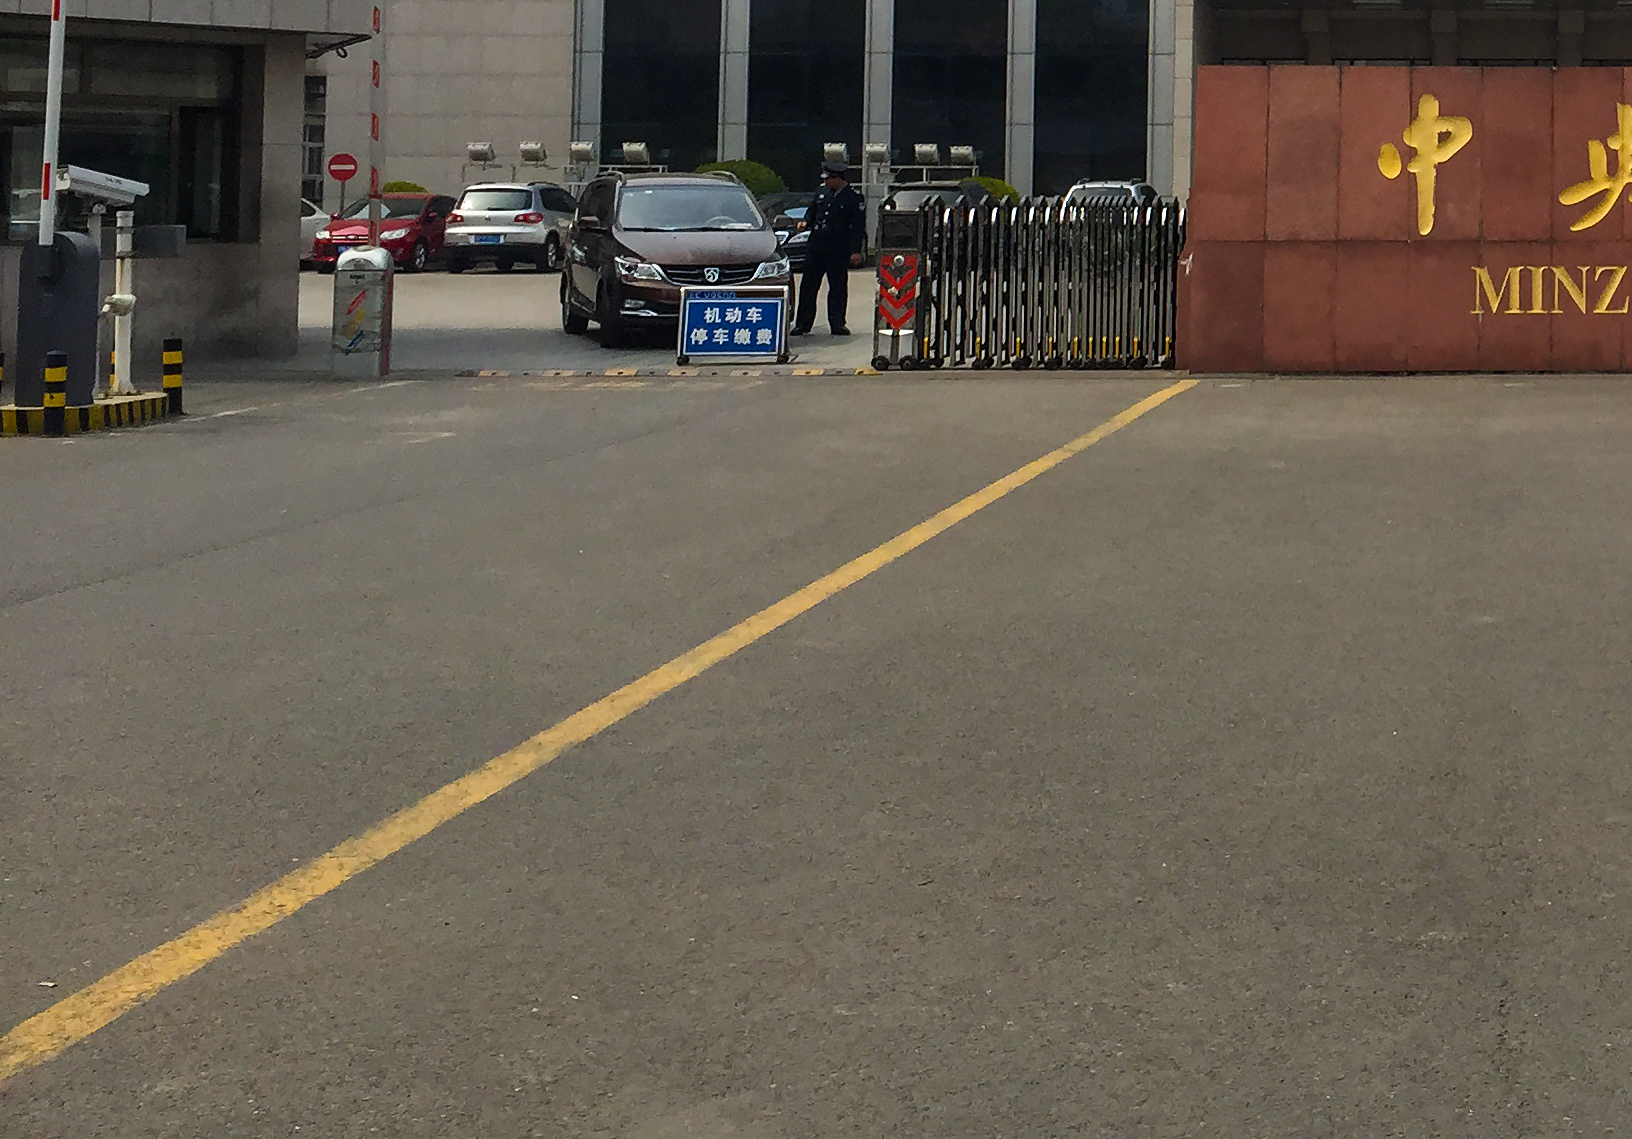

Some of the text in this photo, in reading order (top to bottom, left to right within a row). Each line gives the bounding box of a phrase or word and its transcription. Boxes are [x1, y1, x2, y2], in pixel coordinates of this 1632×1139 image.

[703, 306, 763, 324] 机动车
[690, 327, 773, 345] 停车缴费
